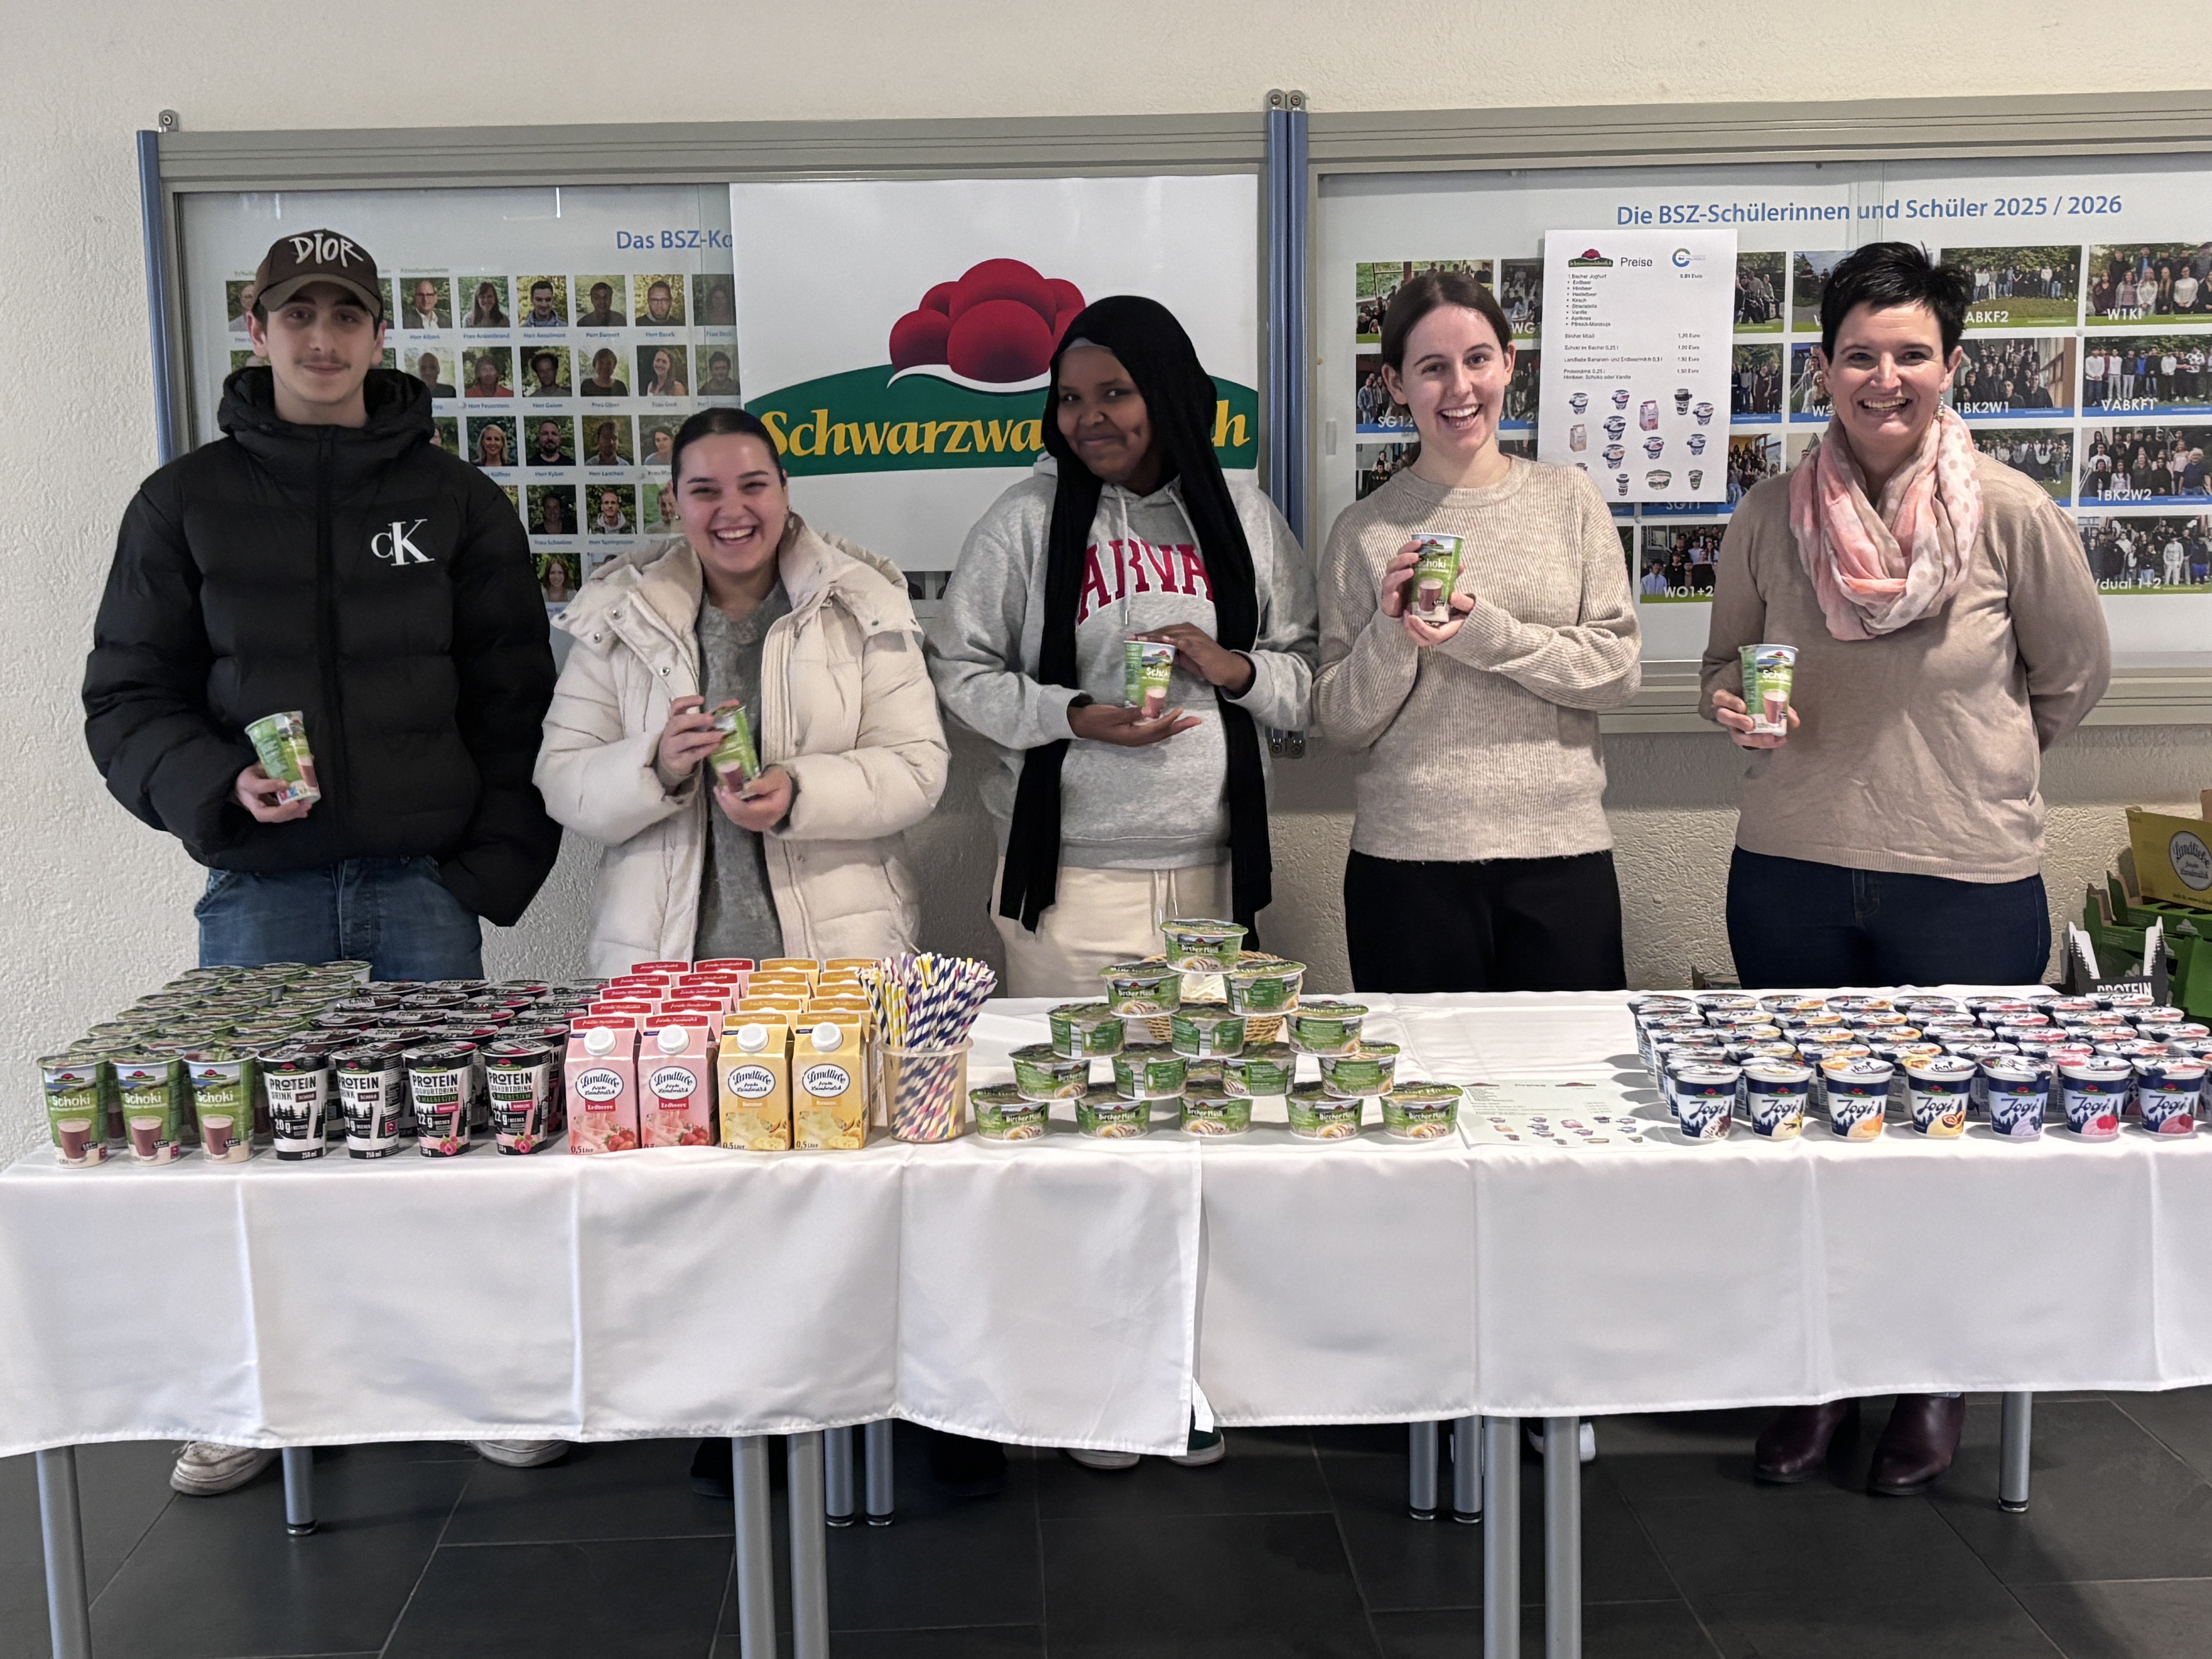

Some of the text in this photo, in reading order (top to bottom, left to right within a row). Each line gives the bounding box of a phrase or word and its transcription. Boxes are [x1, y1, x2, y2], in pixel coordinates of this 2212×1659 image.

[1617, 195, 2122, 225] Die BSZ-Schülerinnen und Schüler 2025 / 2026
[617, 231, 654, 249] Das
[289, 233, 364, 268] DIOR
[1621, 257, 1653, 267] Preise
[760, 400, 1250, 455] Schwarzwah
[2097, 489, 2152, 501] 1BK2W2
[1078, 538, 1214, 625] ARVA
[269, 1076, 316, 1091] PROTEIN
[338, 1077, 379, 1090] PROTEIN
[412, 1074, 458, 1088] PROTEIN
[488, 1072, 532, 1086] PROTEIN
[52, 1093, 91, 1107] Schoki
[124, 1091, 161, 1104] Schoki
[197, 1090, 234, 1104] Schoki
[1917, 1096, 1954, 1116] Jogi
[2071, 1096, 2111, 1116] Jogi
[2148, 1095, 2188, 1115] Jogi
[1689, 1099, 1727, 1120] Jogi
[1761, 1099, 1800, 1120] Jogi
[1836, 1099, 1875, 1119] Jogi
[2000, 1098, 2039, 1117] Jogi
[275, 1118, 291, 1133] 20 g
[417, 1112, 433, 1128] 22 g
